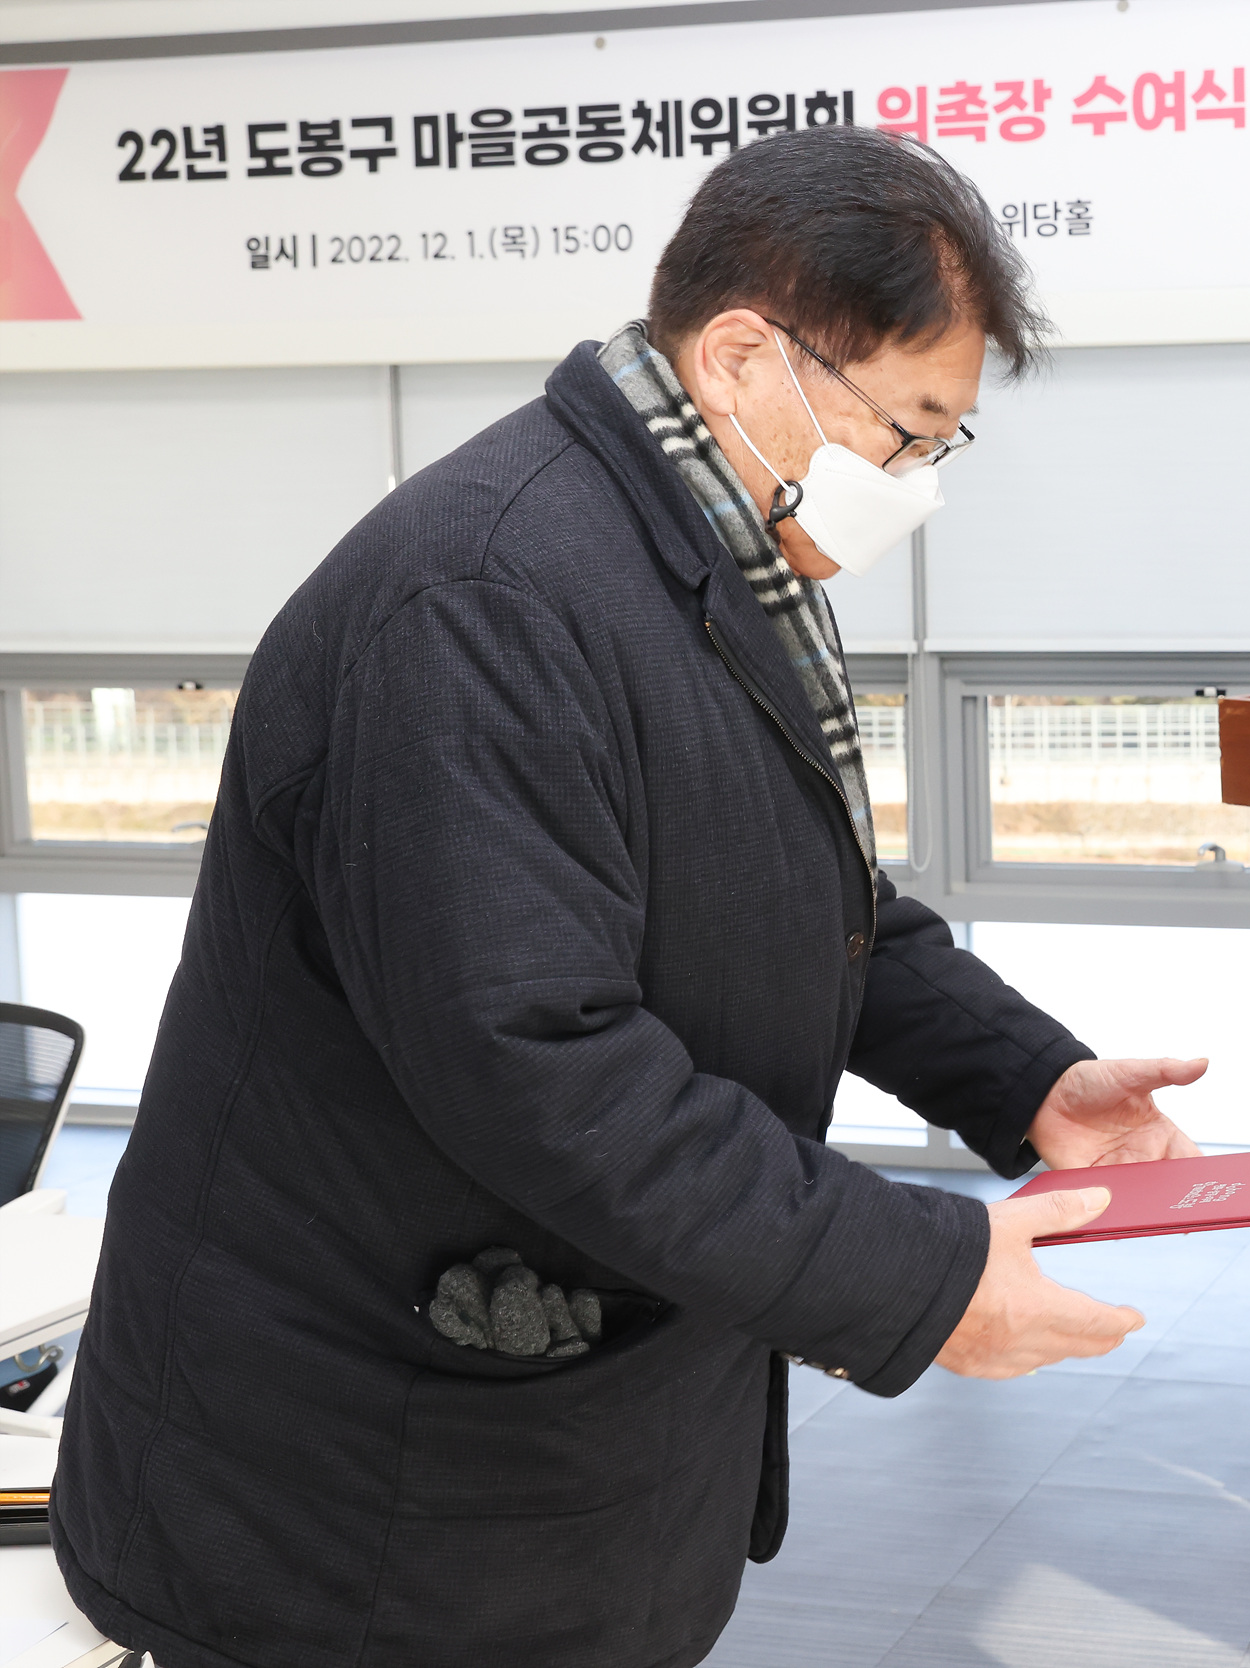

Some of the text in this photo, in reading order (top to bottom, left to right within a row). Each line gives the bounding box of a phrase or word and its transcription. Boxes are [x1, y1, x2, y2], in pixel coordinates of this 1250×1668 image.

[117, 124, 228, 181] 22년
[247, 116, 397, 177] 도봉구
[876, 78, 1052, 144] 위촉장
[1071, 66, 1246, 136] 수여식
[1001, 199, 1094, 238] 위당홀
[246, 234, 298, 269] 일시
[330, 233, 409, 264] 2022.
[420, 231, 455, 260] 12.
[552, 222, 633, 255] 15:00
